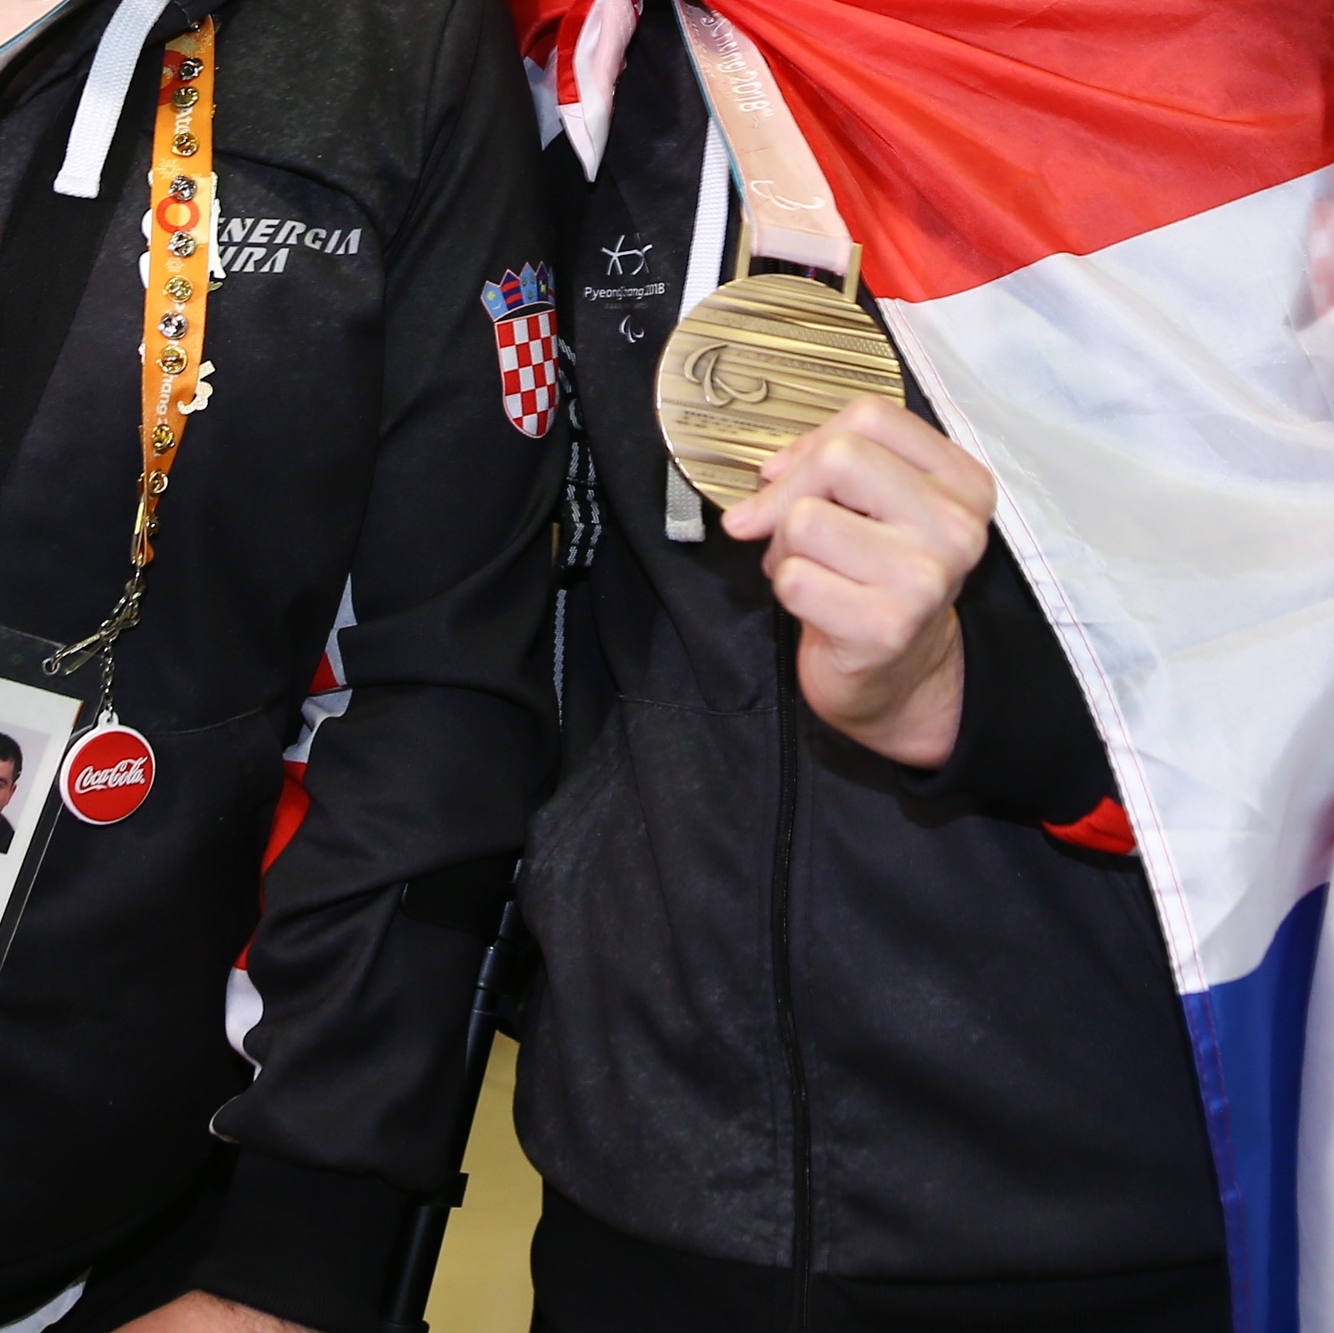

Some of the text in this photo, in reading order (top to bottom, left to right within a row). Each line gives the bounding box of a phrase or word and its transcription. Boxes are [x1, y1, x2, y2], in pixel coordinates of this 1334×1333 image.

[730, 70, 771, 113] 2018
[218, 245, 290, 273] URA
[74, 756, 148, 794] Coca-Cola
